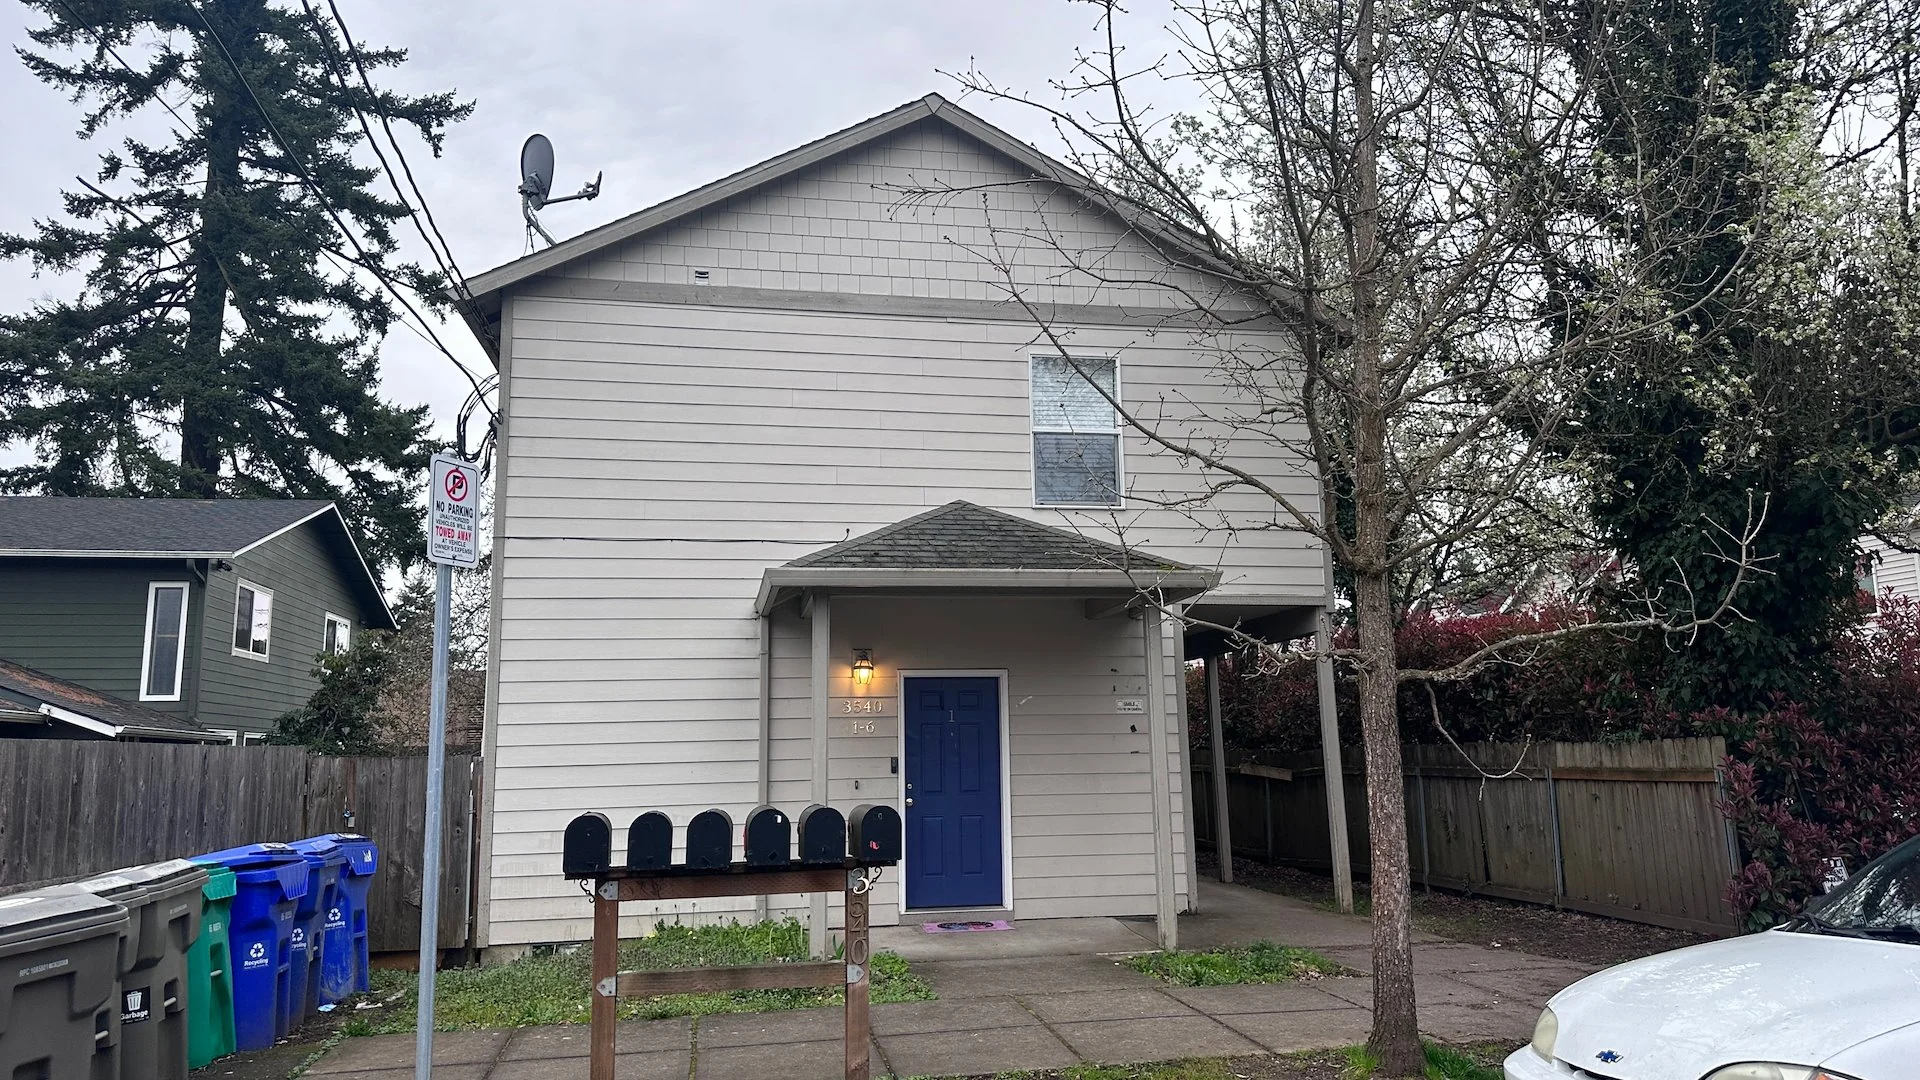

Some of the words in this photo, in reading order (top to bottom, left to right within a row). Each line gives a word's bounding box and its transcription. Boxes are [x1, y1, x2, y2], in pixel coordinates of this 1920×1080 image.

[436, 500, 445, 512] NO
[448, 502, 473, 519] PARKING
[436, 518, 455, 528] VEHICLES
[467, 524, 473, 532] BE
[435, 525, 455, 539] TOWED
[457, 531, 472, 542] AWAY
[434, 543, 454, 552] OWNER'S
[454, 546, 473, 555] EXPENSE
[448, 539, 467, 548] VEHICLE
[842, 700, 883, 714] 3540
[948, 709, 955, 723] 1
[852, 720, 875, 735] 1-6
[324, 921, 346, 929] Recycling
[243, 959, 269, 967] Recycling
[120, 1010, 149, 1021] Garbage
